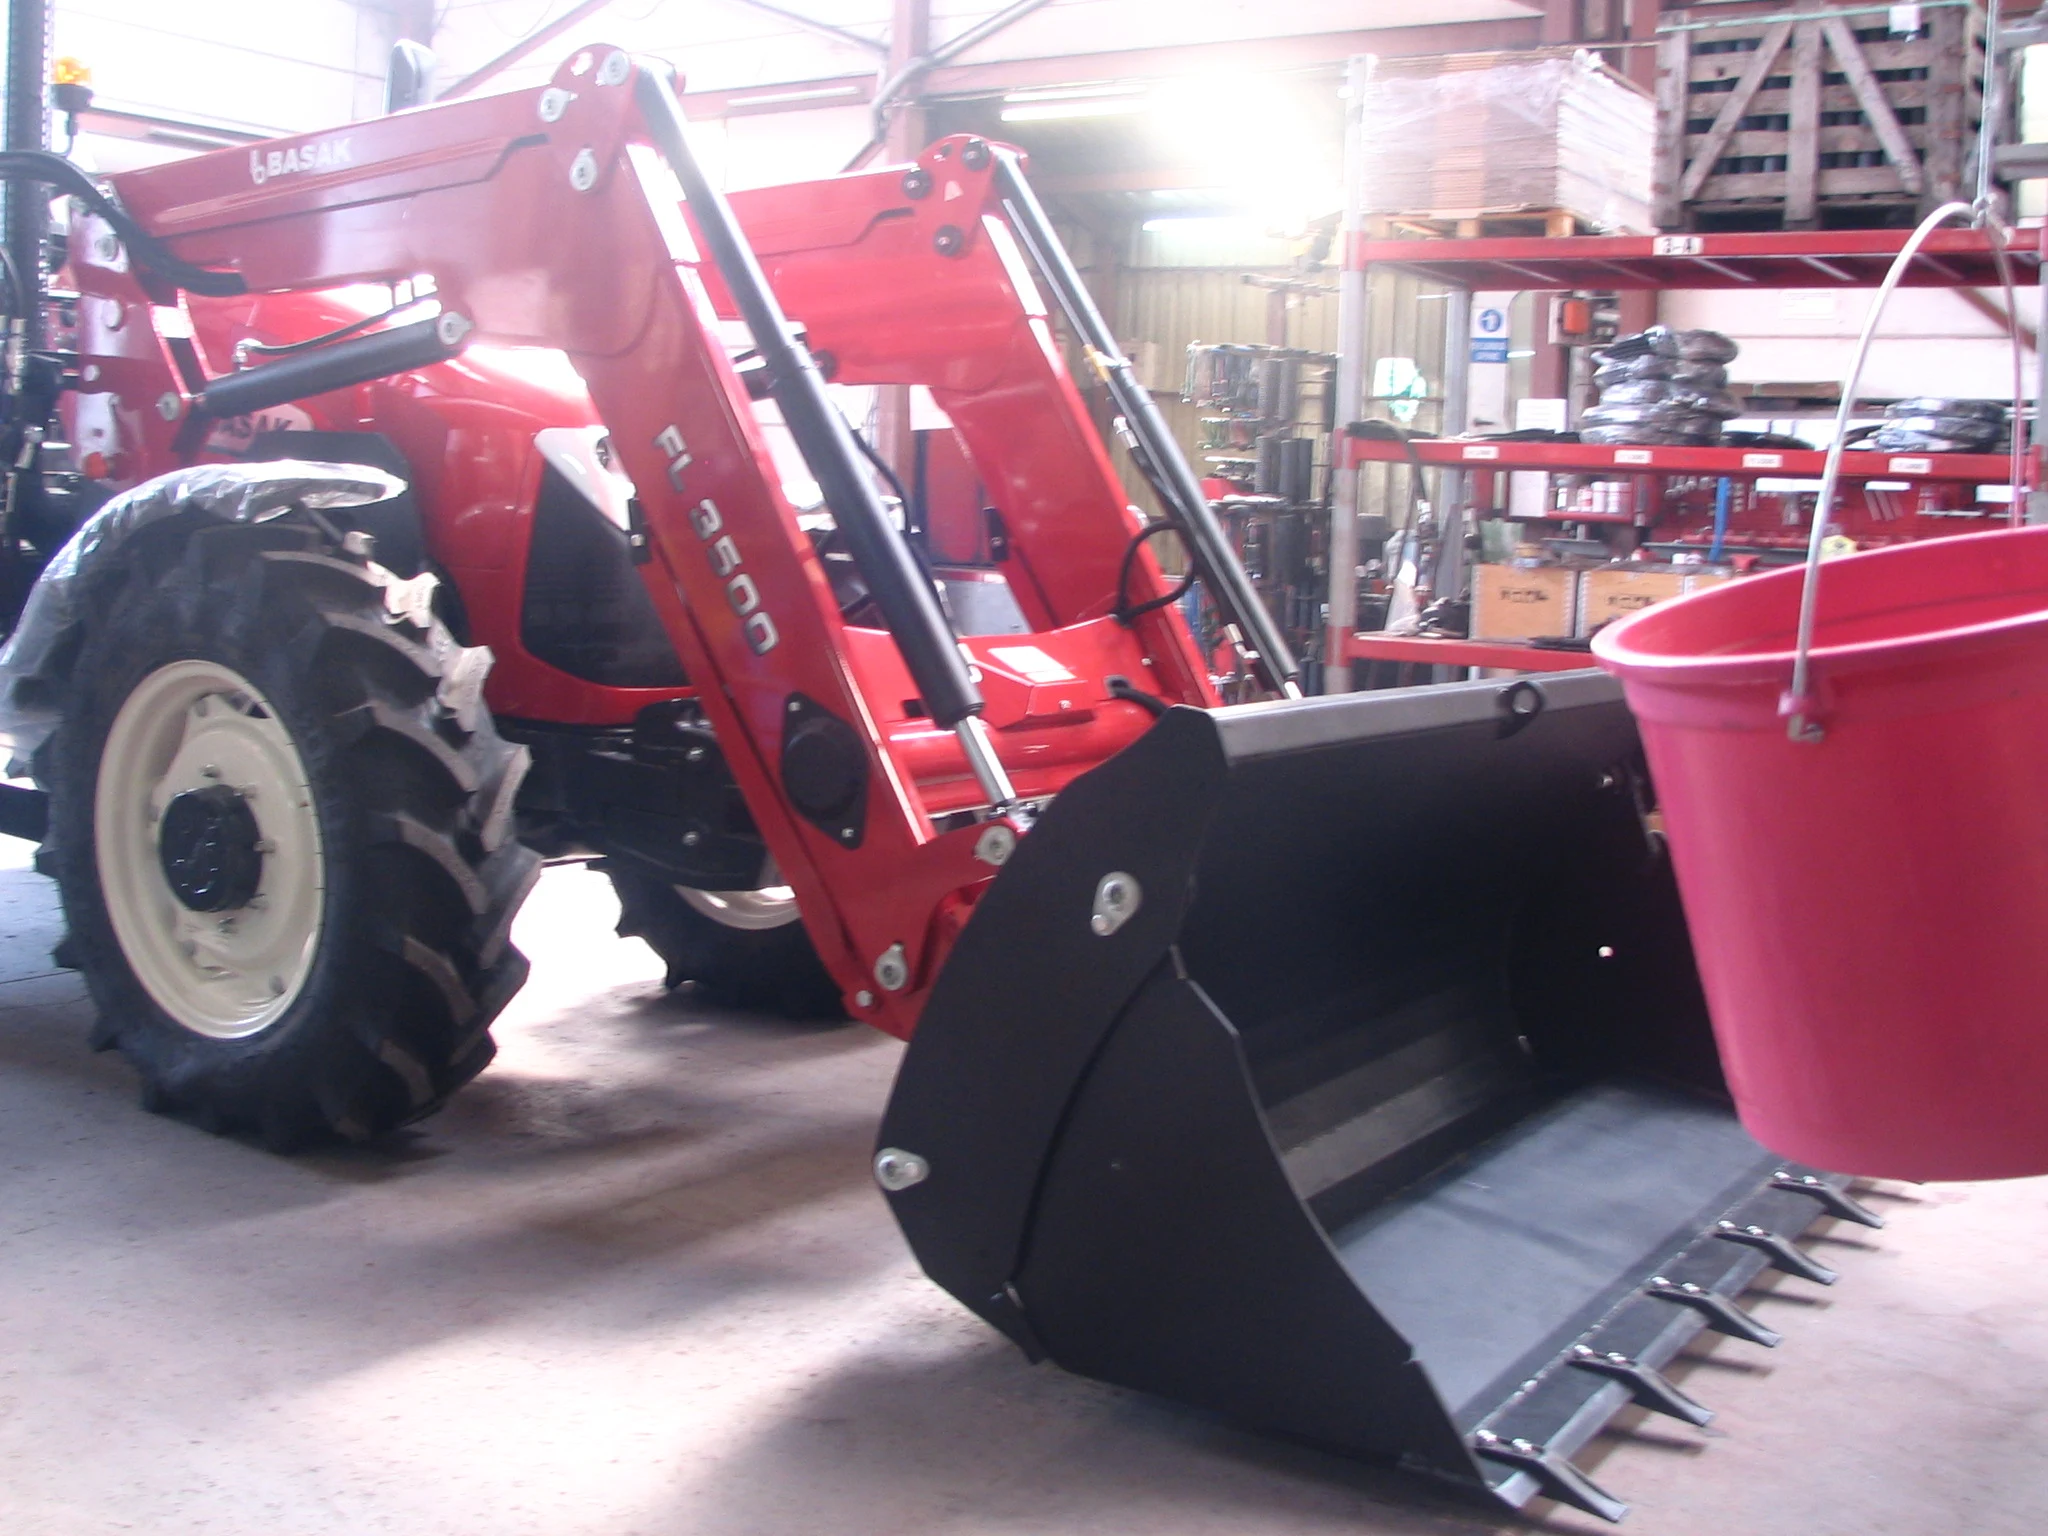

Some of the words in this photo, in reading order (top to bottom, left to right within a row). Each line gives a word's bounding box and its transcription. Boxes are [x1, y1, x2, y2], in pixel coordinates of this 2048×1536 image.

[266, 138, 352, 177] BASAK
[653, 424, 693, 493] FL
[689, 498, 780, 656] 3500
